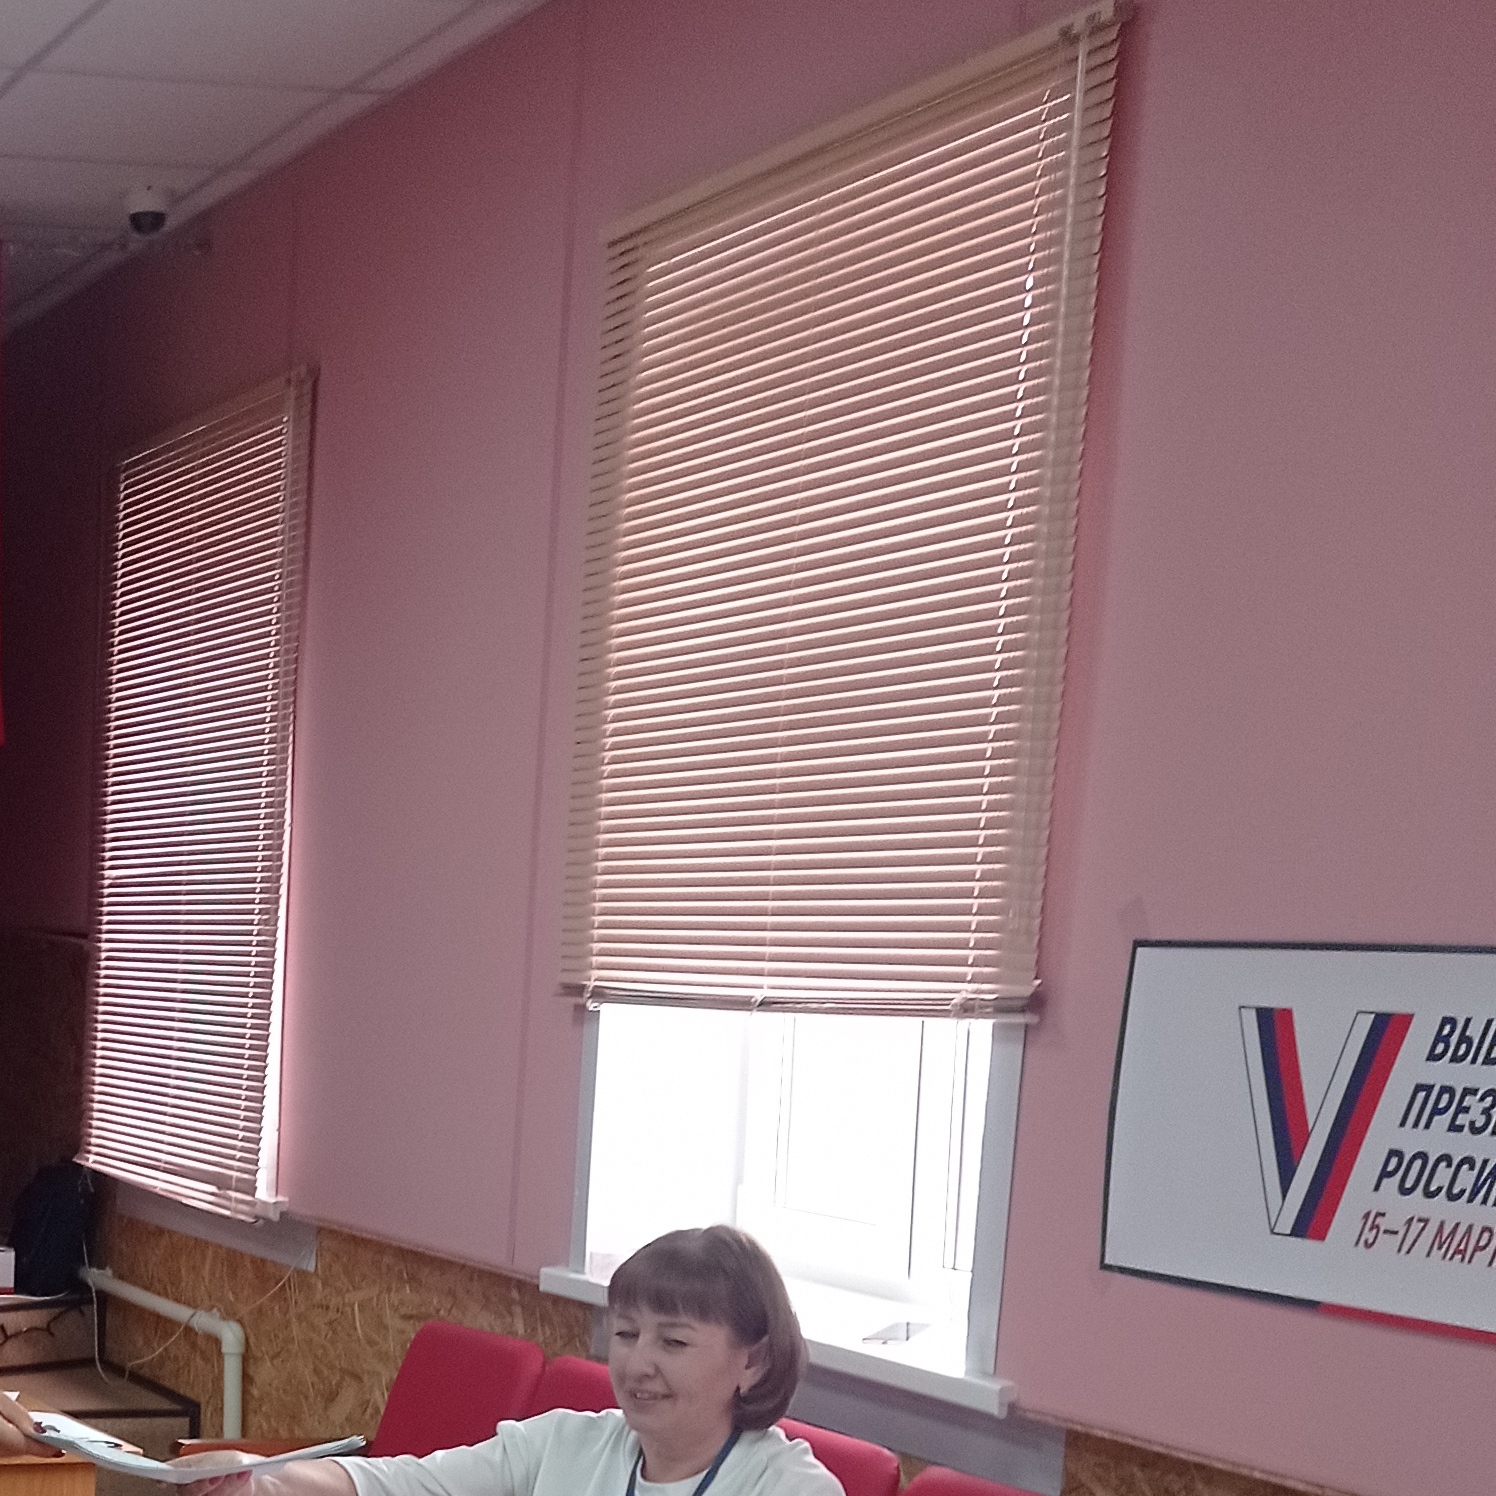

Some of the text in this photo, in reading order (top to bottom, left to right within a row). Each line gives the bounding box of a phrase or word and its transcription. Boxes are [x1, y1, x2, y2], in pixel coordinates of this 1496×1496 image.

[1399, 1083, 1496, 1137] ПРЕЗ
[1373, 1148, 1496, 1207] РОССИ
[1426, 1219, 1496, 1268] МАР
